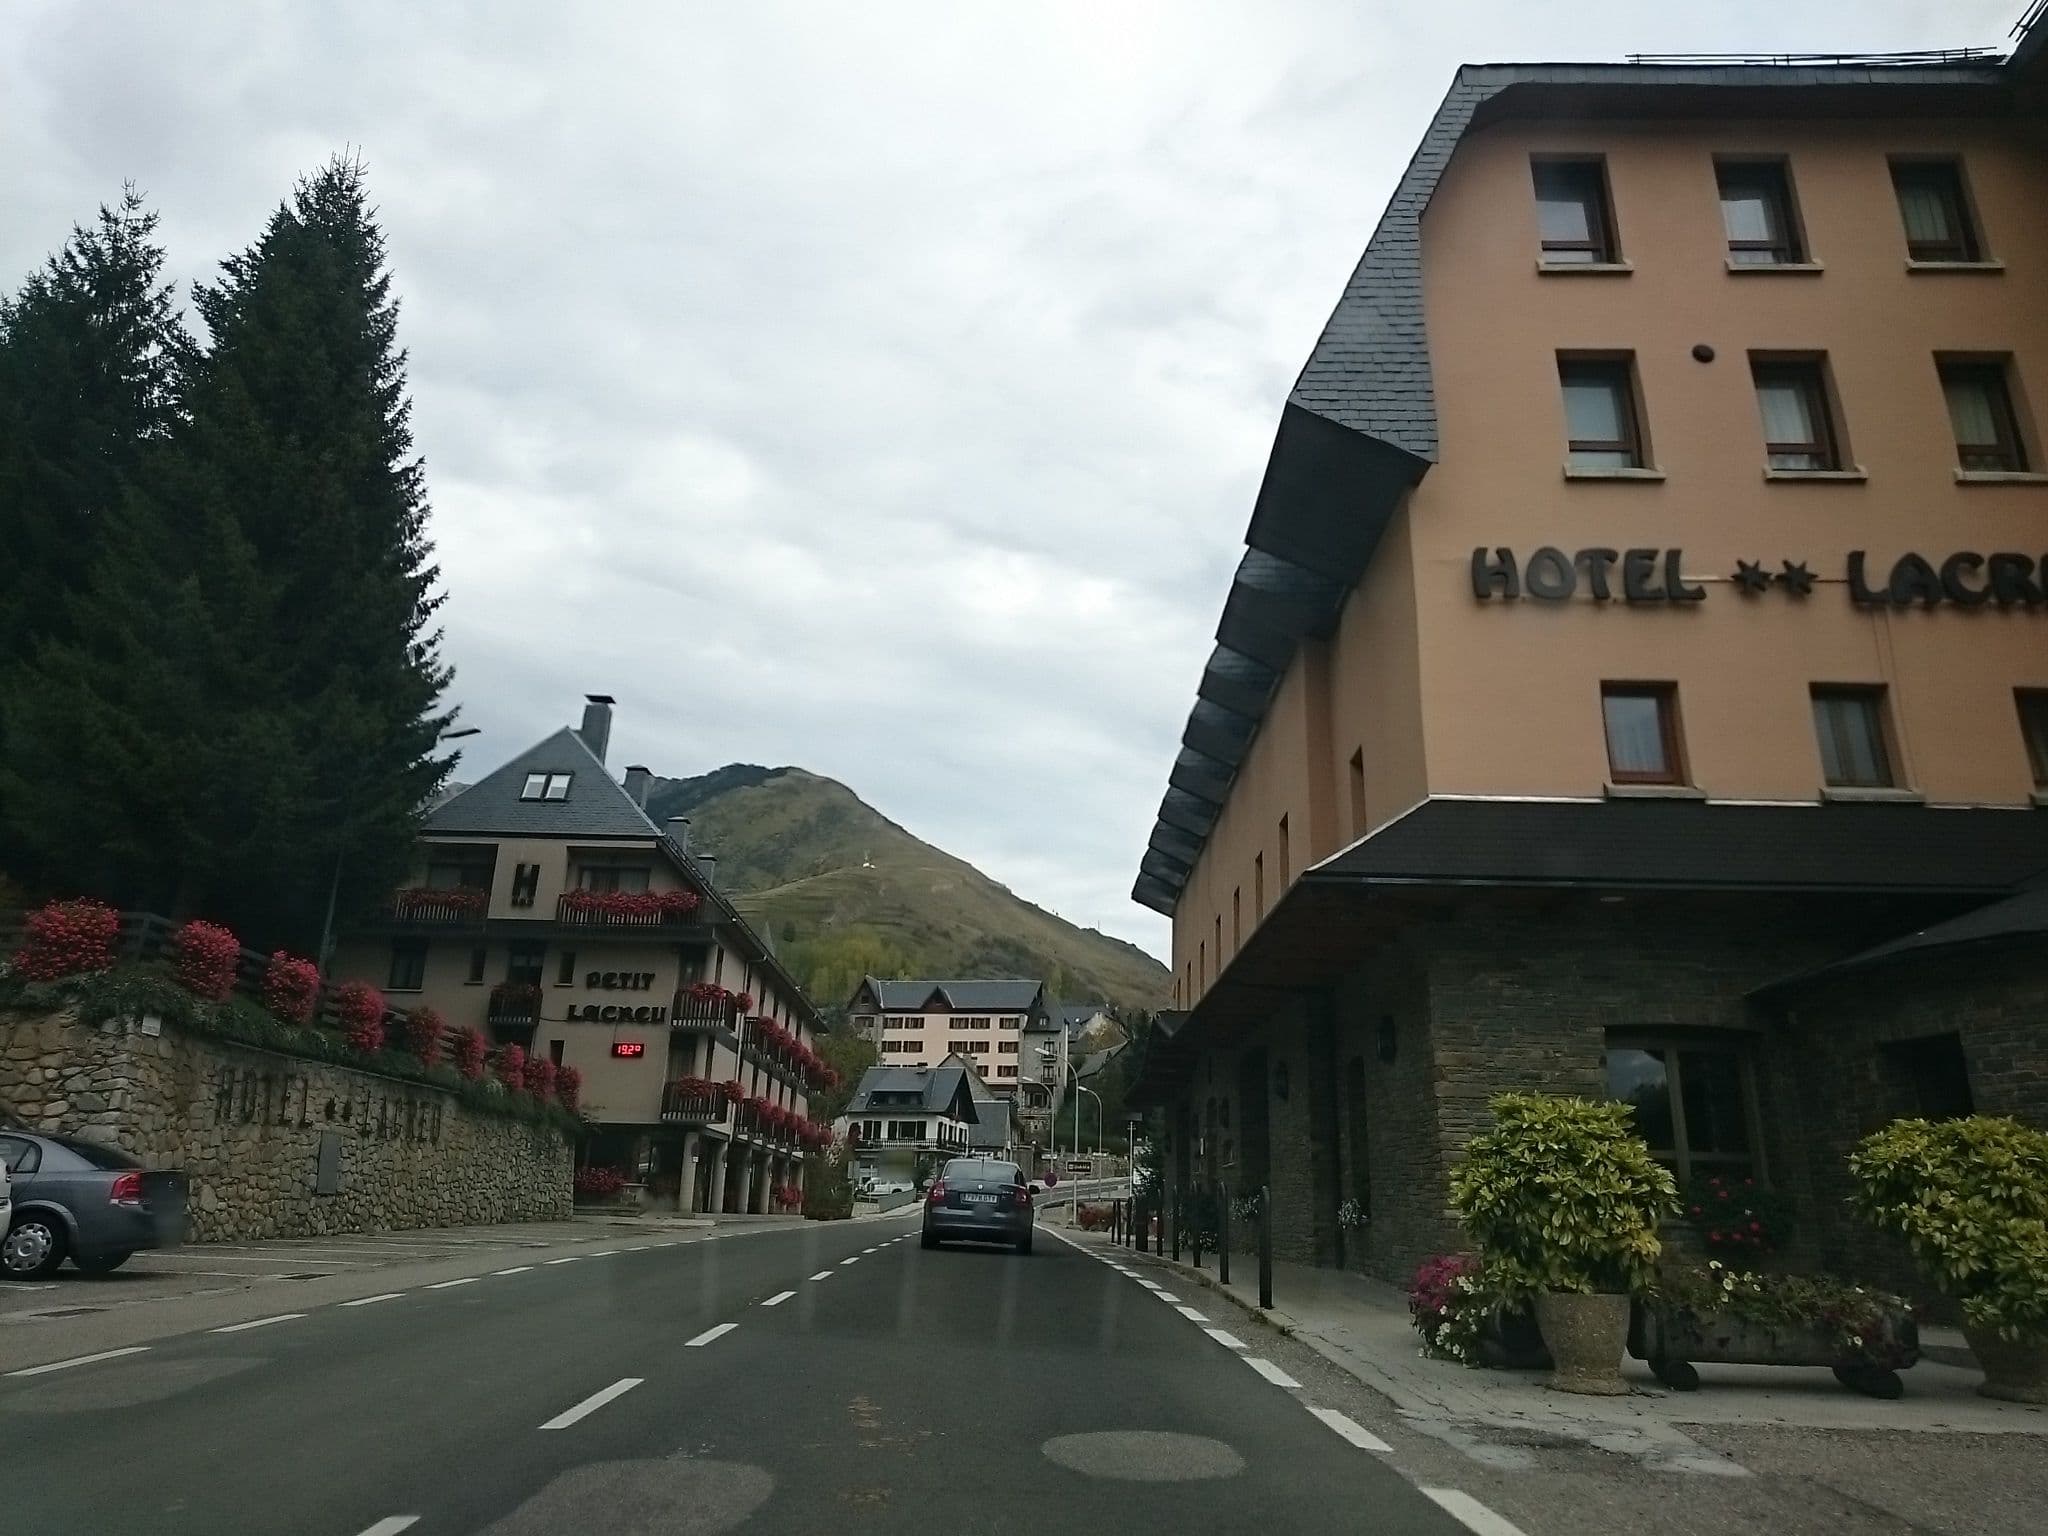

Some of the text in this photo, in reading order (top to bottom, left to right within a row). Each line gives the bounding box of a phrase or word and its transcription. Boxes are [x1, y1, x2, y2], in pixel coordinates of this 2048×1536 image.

[1471, 547, 1706, 600] HOTEL
[586, 972, 656, 990] PETIT
[215, 1066, 312, 1130] HOTEL
